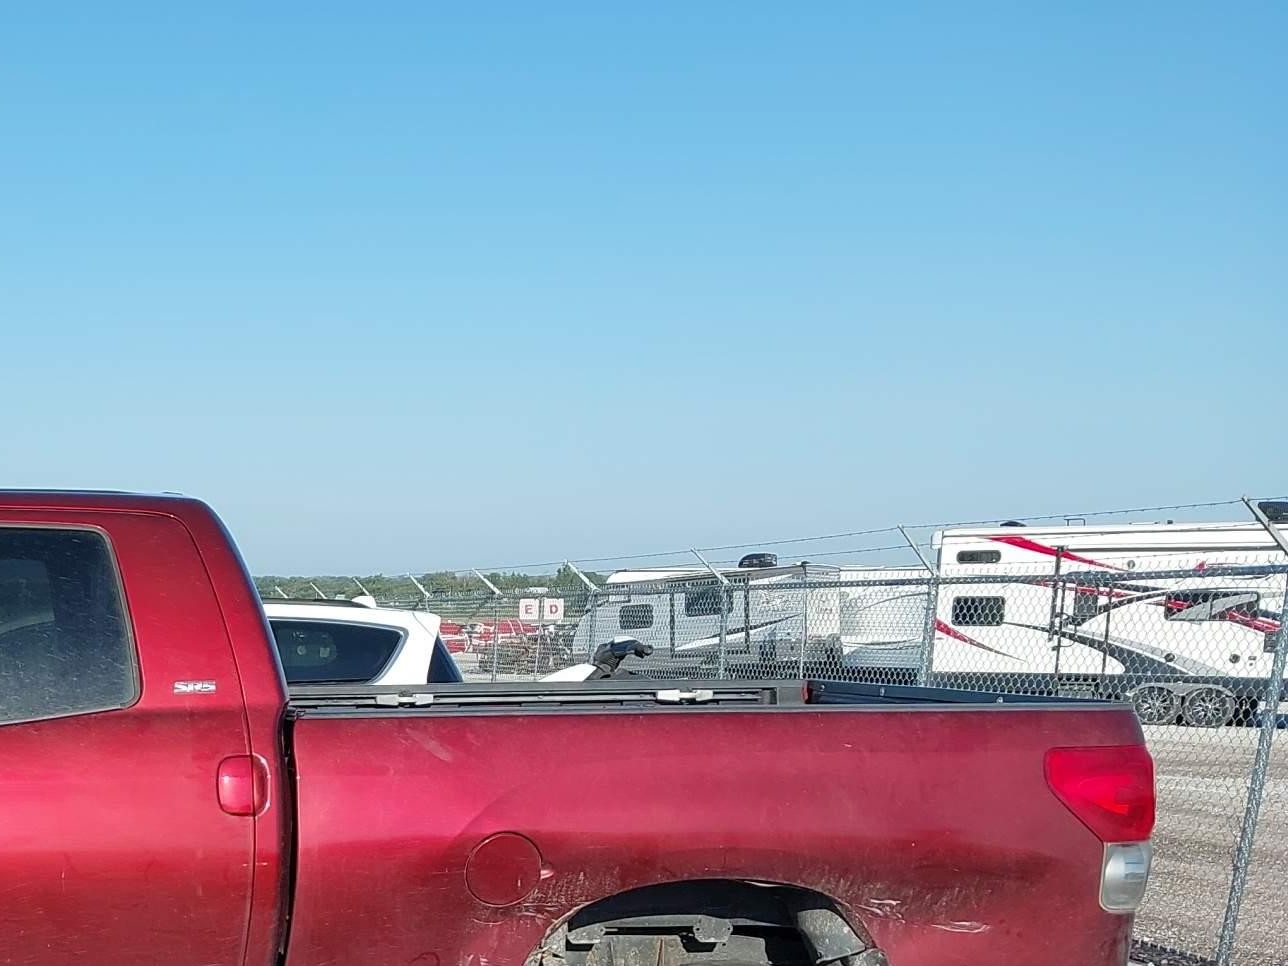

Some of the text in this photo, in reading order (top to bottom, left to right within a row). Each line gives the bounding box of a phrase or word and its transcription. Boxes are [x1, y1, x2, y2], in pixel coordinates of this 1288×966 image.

[524, 604, 533, 614] E
[549, 604, 559, 614] D
[173, 679, 217, 694] SR5
